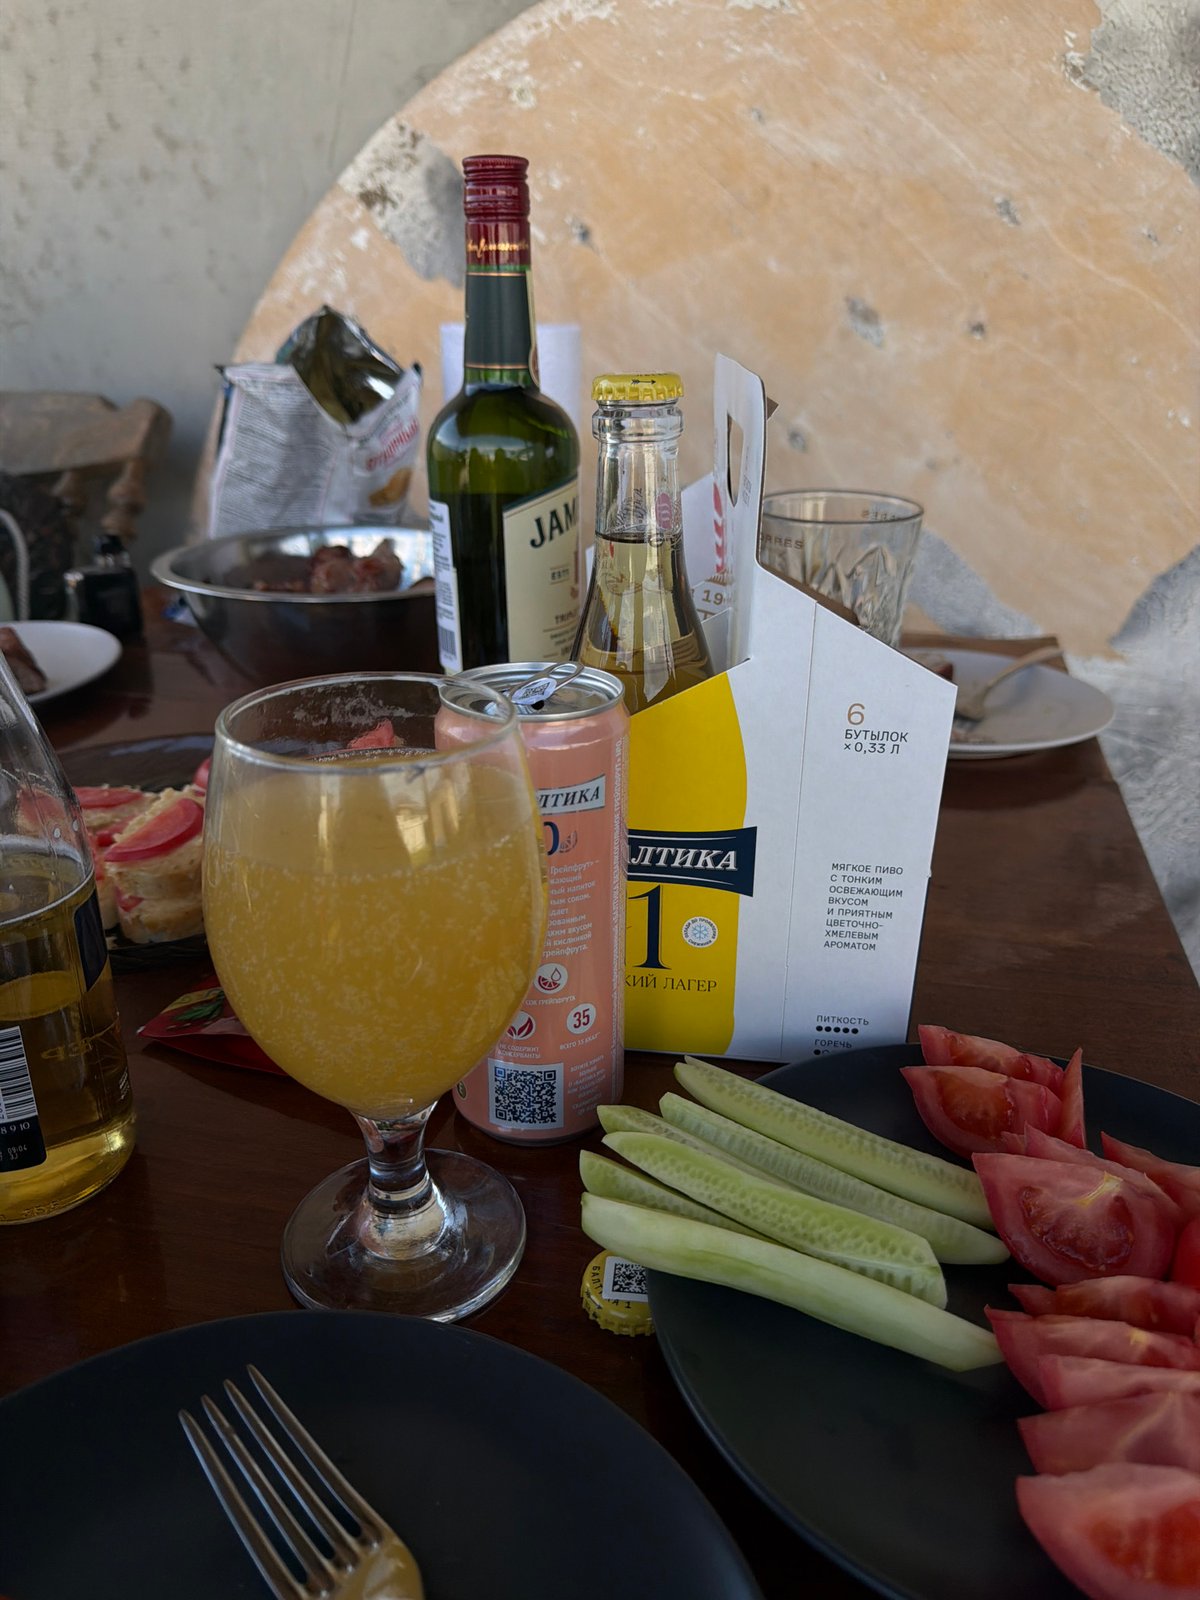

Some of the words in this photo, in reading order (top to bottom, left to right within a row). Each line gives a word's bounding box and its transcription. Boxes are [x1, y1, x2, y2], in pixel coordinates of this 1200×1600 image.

[847, 703, 865, 725] 6
[844, 729, 909, 742] БУТЫЛОК
[890, 744, 900, 754] Л
[831, 863, 872, 873] МЯГКОЕ
[875, 866, 904, 875] ПИВО
[830, 874, 838, 882] С
[841, 875, 882, 885] ТОНКИМ
[829, 885, 903, 897] ОСВЕЖАЮЩИМ
[828, 896, 869, 906] ВКУСОМ
[837, 908, 893, 919] ПРИЯТНЫМ
[628, 884, 672, 970] 1
[826, 919, 884, 929] ЦВЕТОЧНО-
[825, 930, 879, 940] ХМЕЛЕВЫМ
[824, 941, 876, 950] АРОМАТОМ
[663, 977, 717, 993] ЛАГЕР
[573, 1008, 590, 1029] 35
[816, 1015, 869, 1026] ПИТКОСТЬ
[814, 1039, 853, 1049] ГОРЕЧЬ
[0, 1126, 8, 1135] 8
[9, 1125, 17, 1133] 9
[19, 1121, 31, 1131] 10
